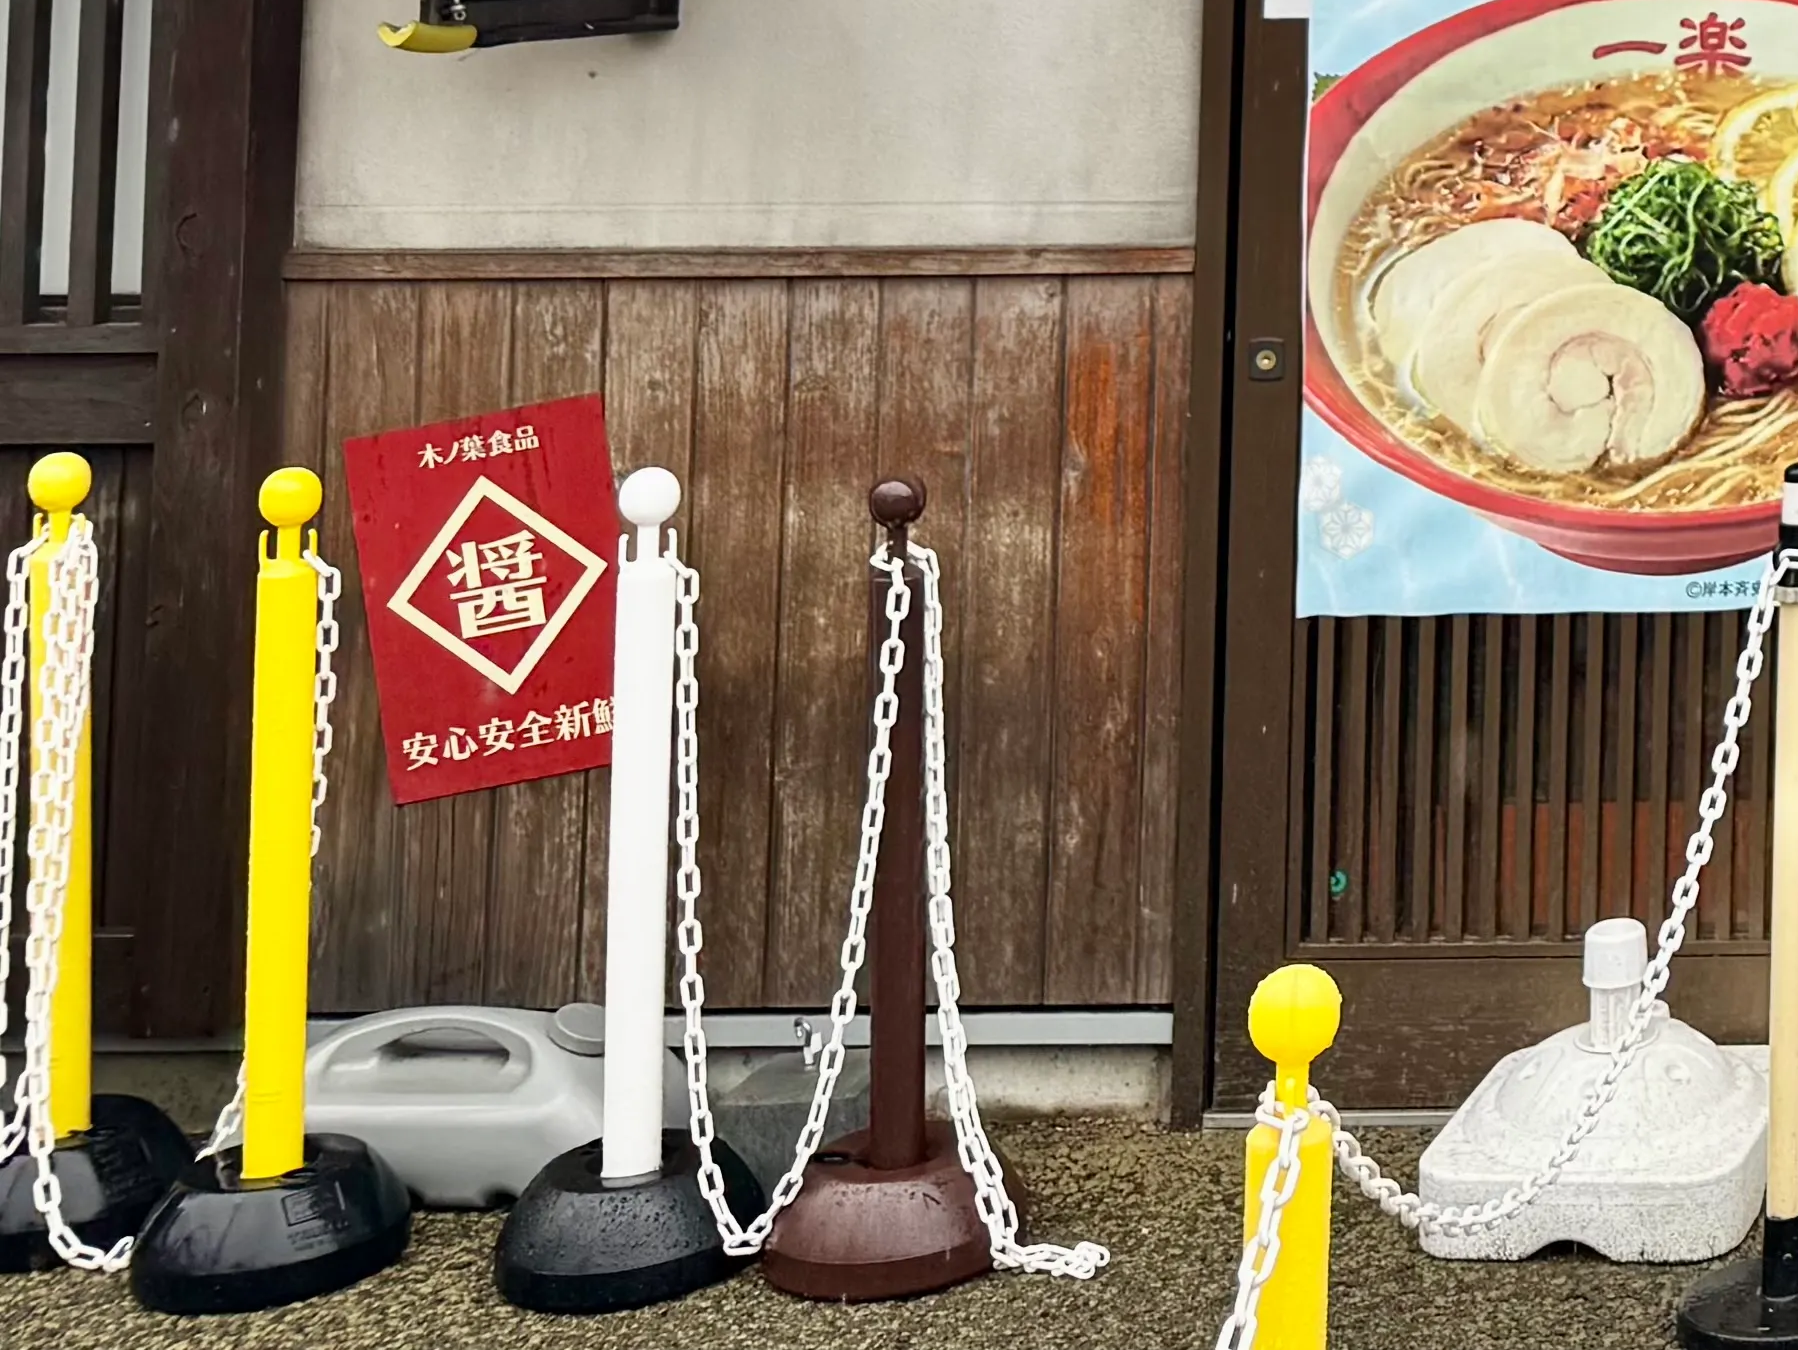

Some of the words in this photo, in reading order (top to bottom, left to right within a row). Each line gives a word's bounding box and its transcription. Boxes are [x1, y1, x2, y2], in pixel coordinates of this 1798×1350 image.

[1592, 11, 1753, 82] 一楽
[416, 425, 540, 469] 木ノ葉食品
[445, 529, 550, 640] 醤
